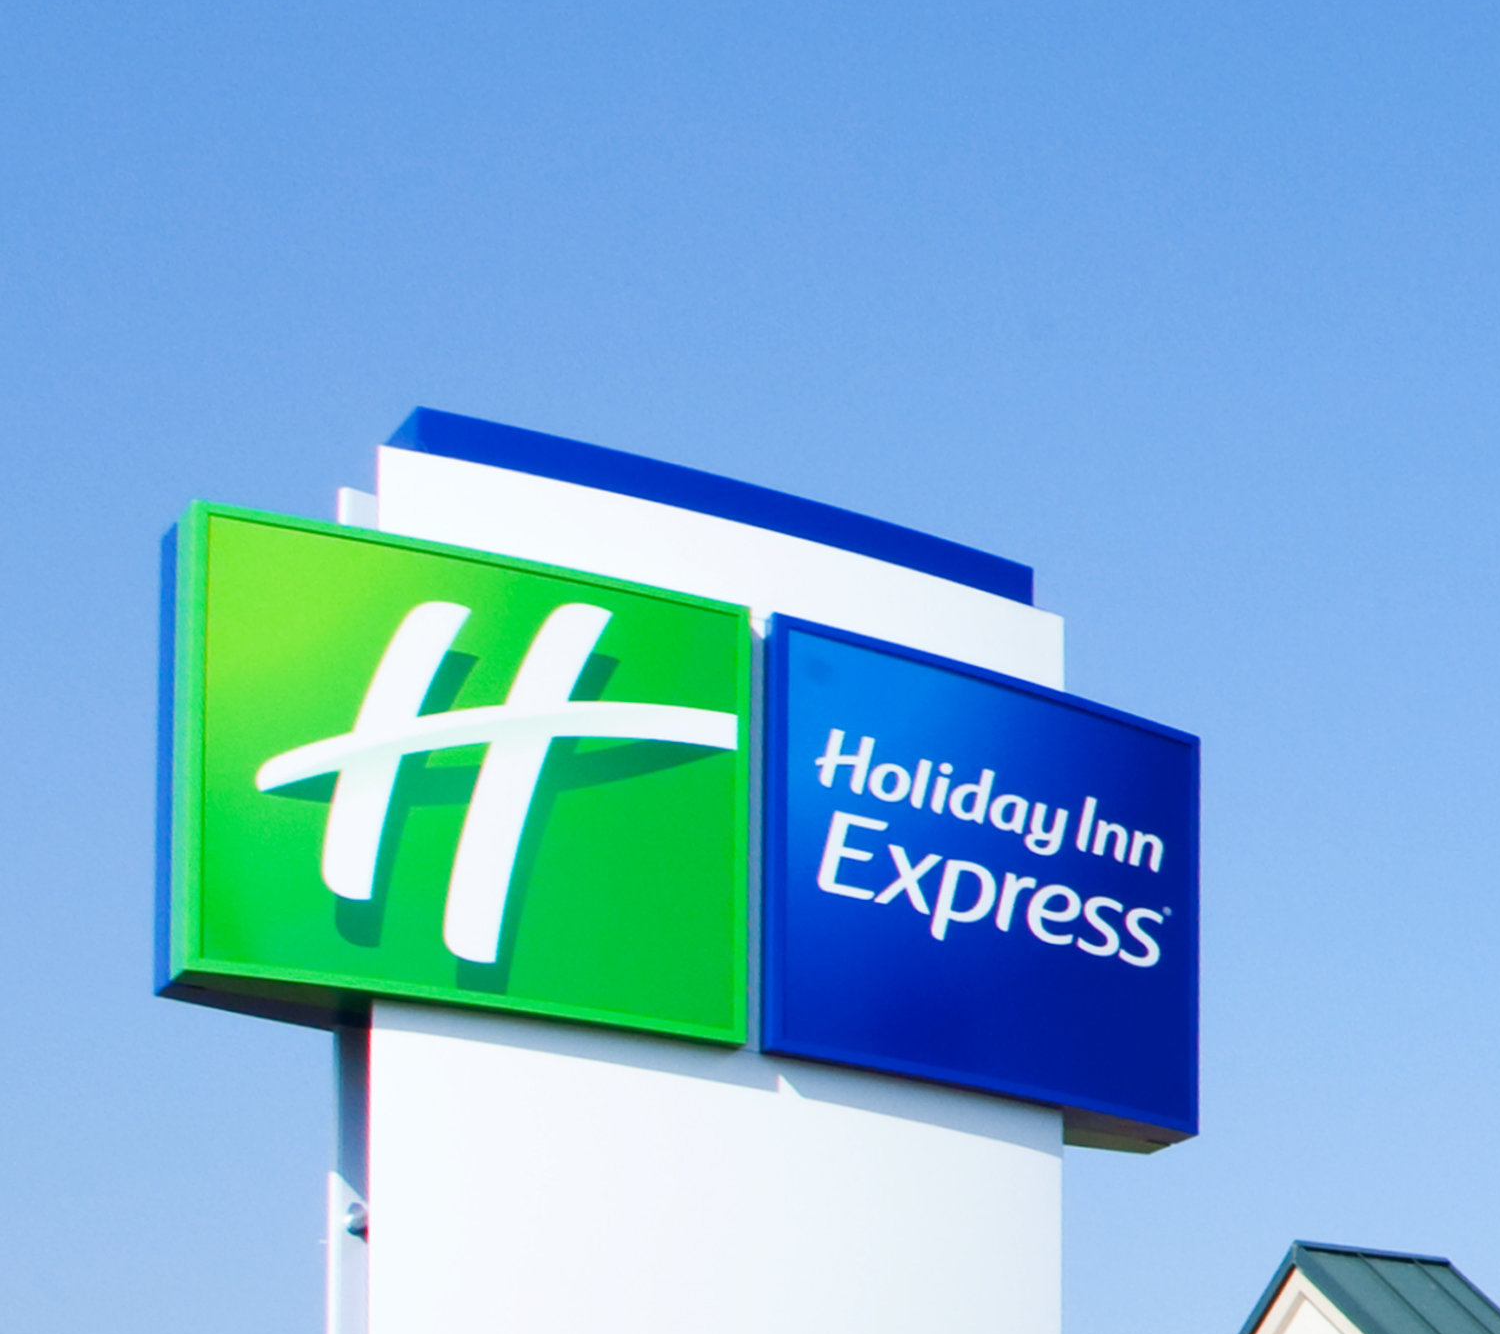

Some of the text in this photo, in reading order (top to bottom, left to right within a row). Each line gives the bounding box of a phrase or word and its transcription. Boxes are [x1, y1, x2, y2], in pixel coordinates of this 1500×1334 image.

[815, 727, 1164, 873] Holiday Inn
[816, 809, 1166, 969] Express
